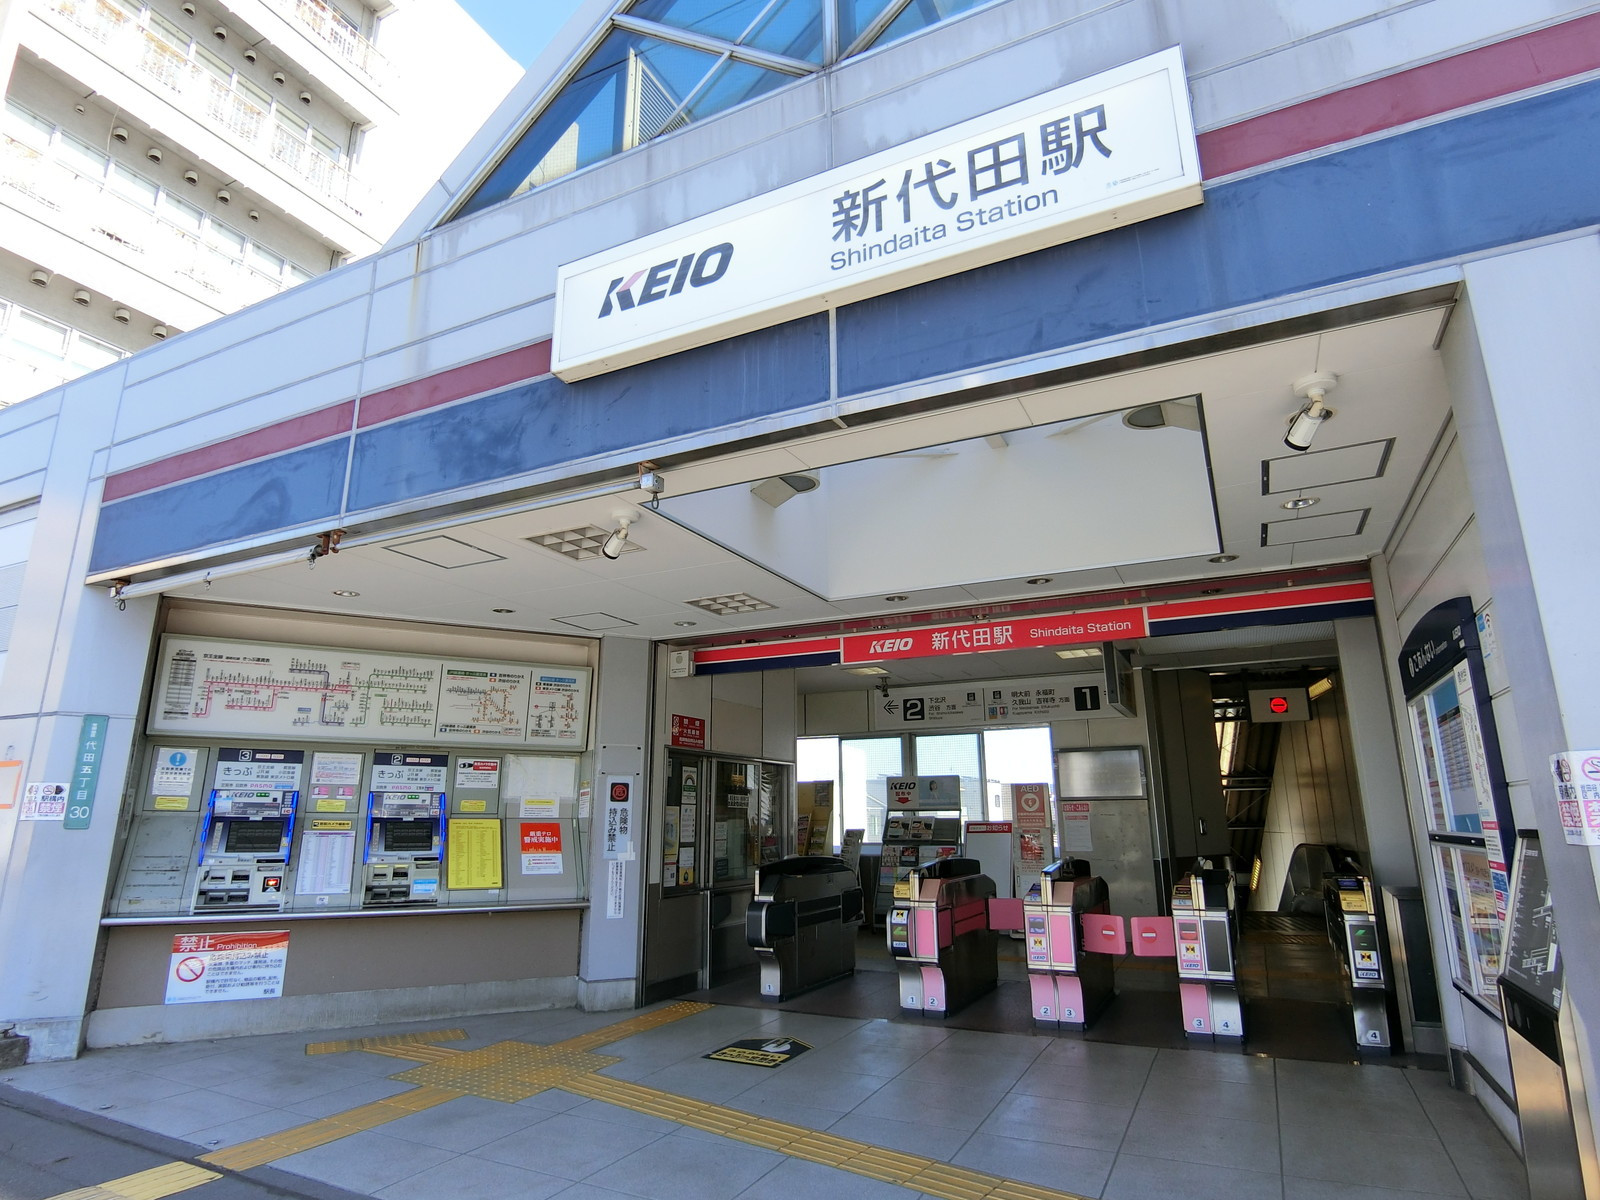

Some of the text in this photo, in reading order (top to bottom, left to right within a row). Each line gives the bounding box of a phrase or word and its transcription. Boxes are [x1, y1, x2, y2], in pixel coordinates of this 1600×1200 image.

[832, 104, 1113, 245] 新代田駅
[830, 187, 1059, 271] Shindaita Station
[598, 242, 733, 318] KEIO
[869, 620, 1132, 654] KEIO 新代田駅 Shindaita Station
[1011, 690, 1031, 698] 明大前
[1081, 688, 1092, 709] 1
[1012, 698, 1031, 706] 久我山
[1036, 697, 1056, 705] 吉祥寺
[906, 700, 921, 720] 2
[241, 751, 250, 760] 3
[393, 755, 401, 764] 2
[76, 741, 97, 800] 代田五丁目
[223, 766, 253, 776] きっぷ
[378, 770, 404, 779] きっぷ
[890, 781, 916, 790] KEIO
[69, 806, 90, 818] 30
[619, 807, 629, 835] 危険物
[606, 808, 618, 852] 持込み禁止
[180, 935, 215, 952] 禁止
[1066, 1009, 1073, 1017] 3
[1195, 1019, 1202, 1027] 3
[1222, 1021, 1229, 1029] 4
